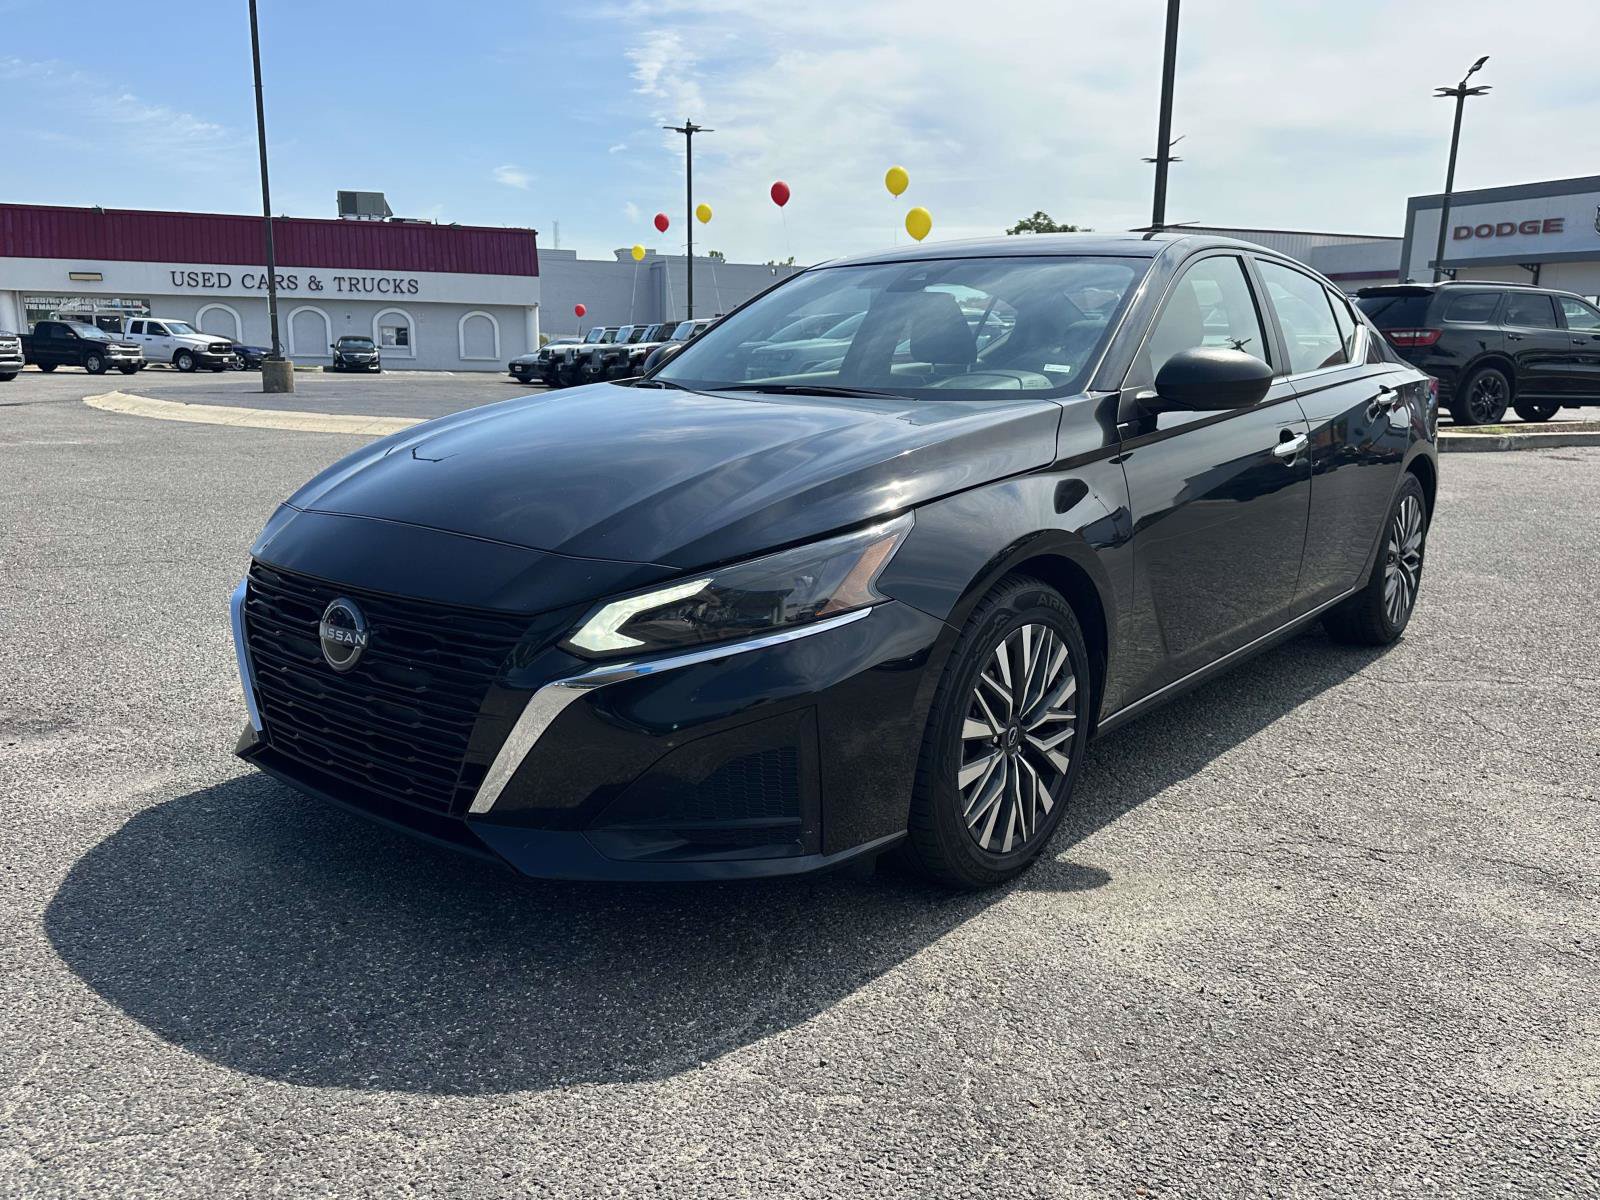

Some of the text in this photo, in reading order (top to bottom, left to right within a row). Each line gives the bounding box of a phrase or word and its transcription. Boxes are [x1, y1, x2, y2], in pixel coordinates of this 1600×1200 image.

[1453, 217, 1566, 241] DODGE
[170, 271, 419, 294] USED CARS & TRUCKS
[321, 625, 366, 645] SSAN
